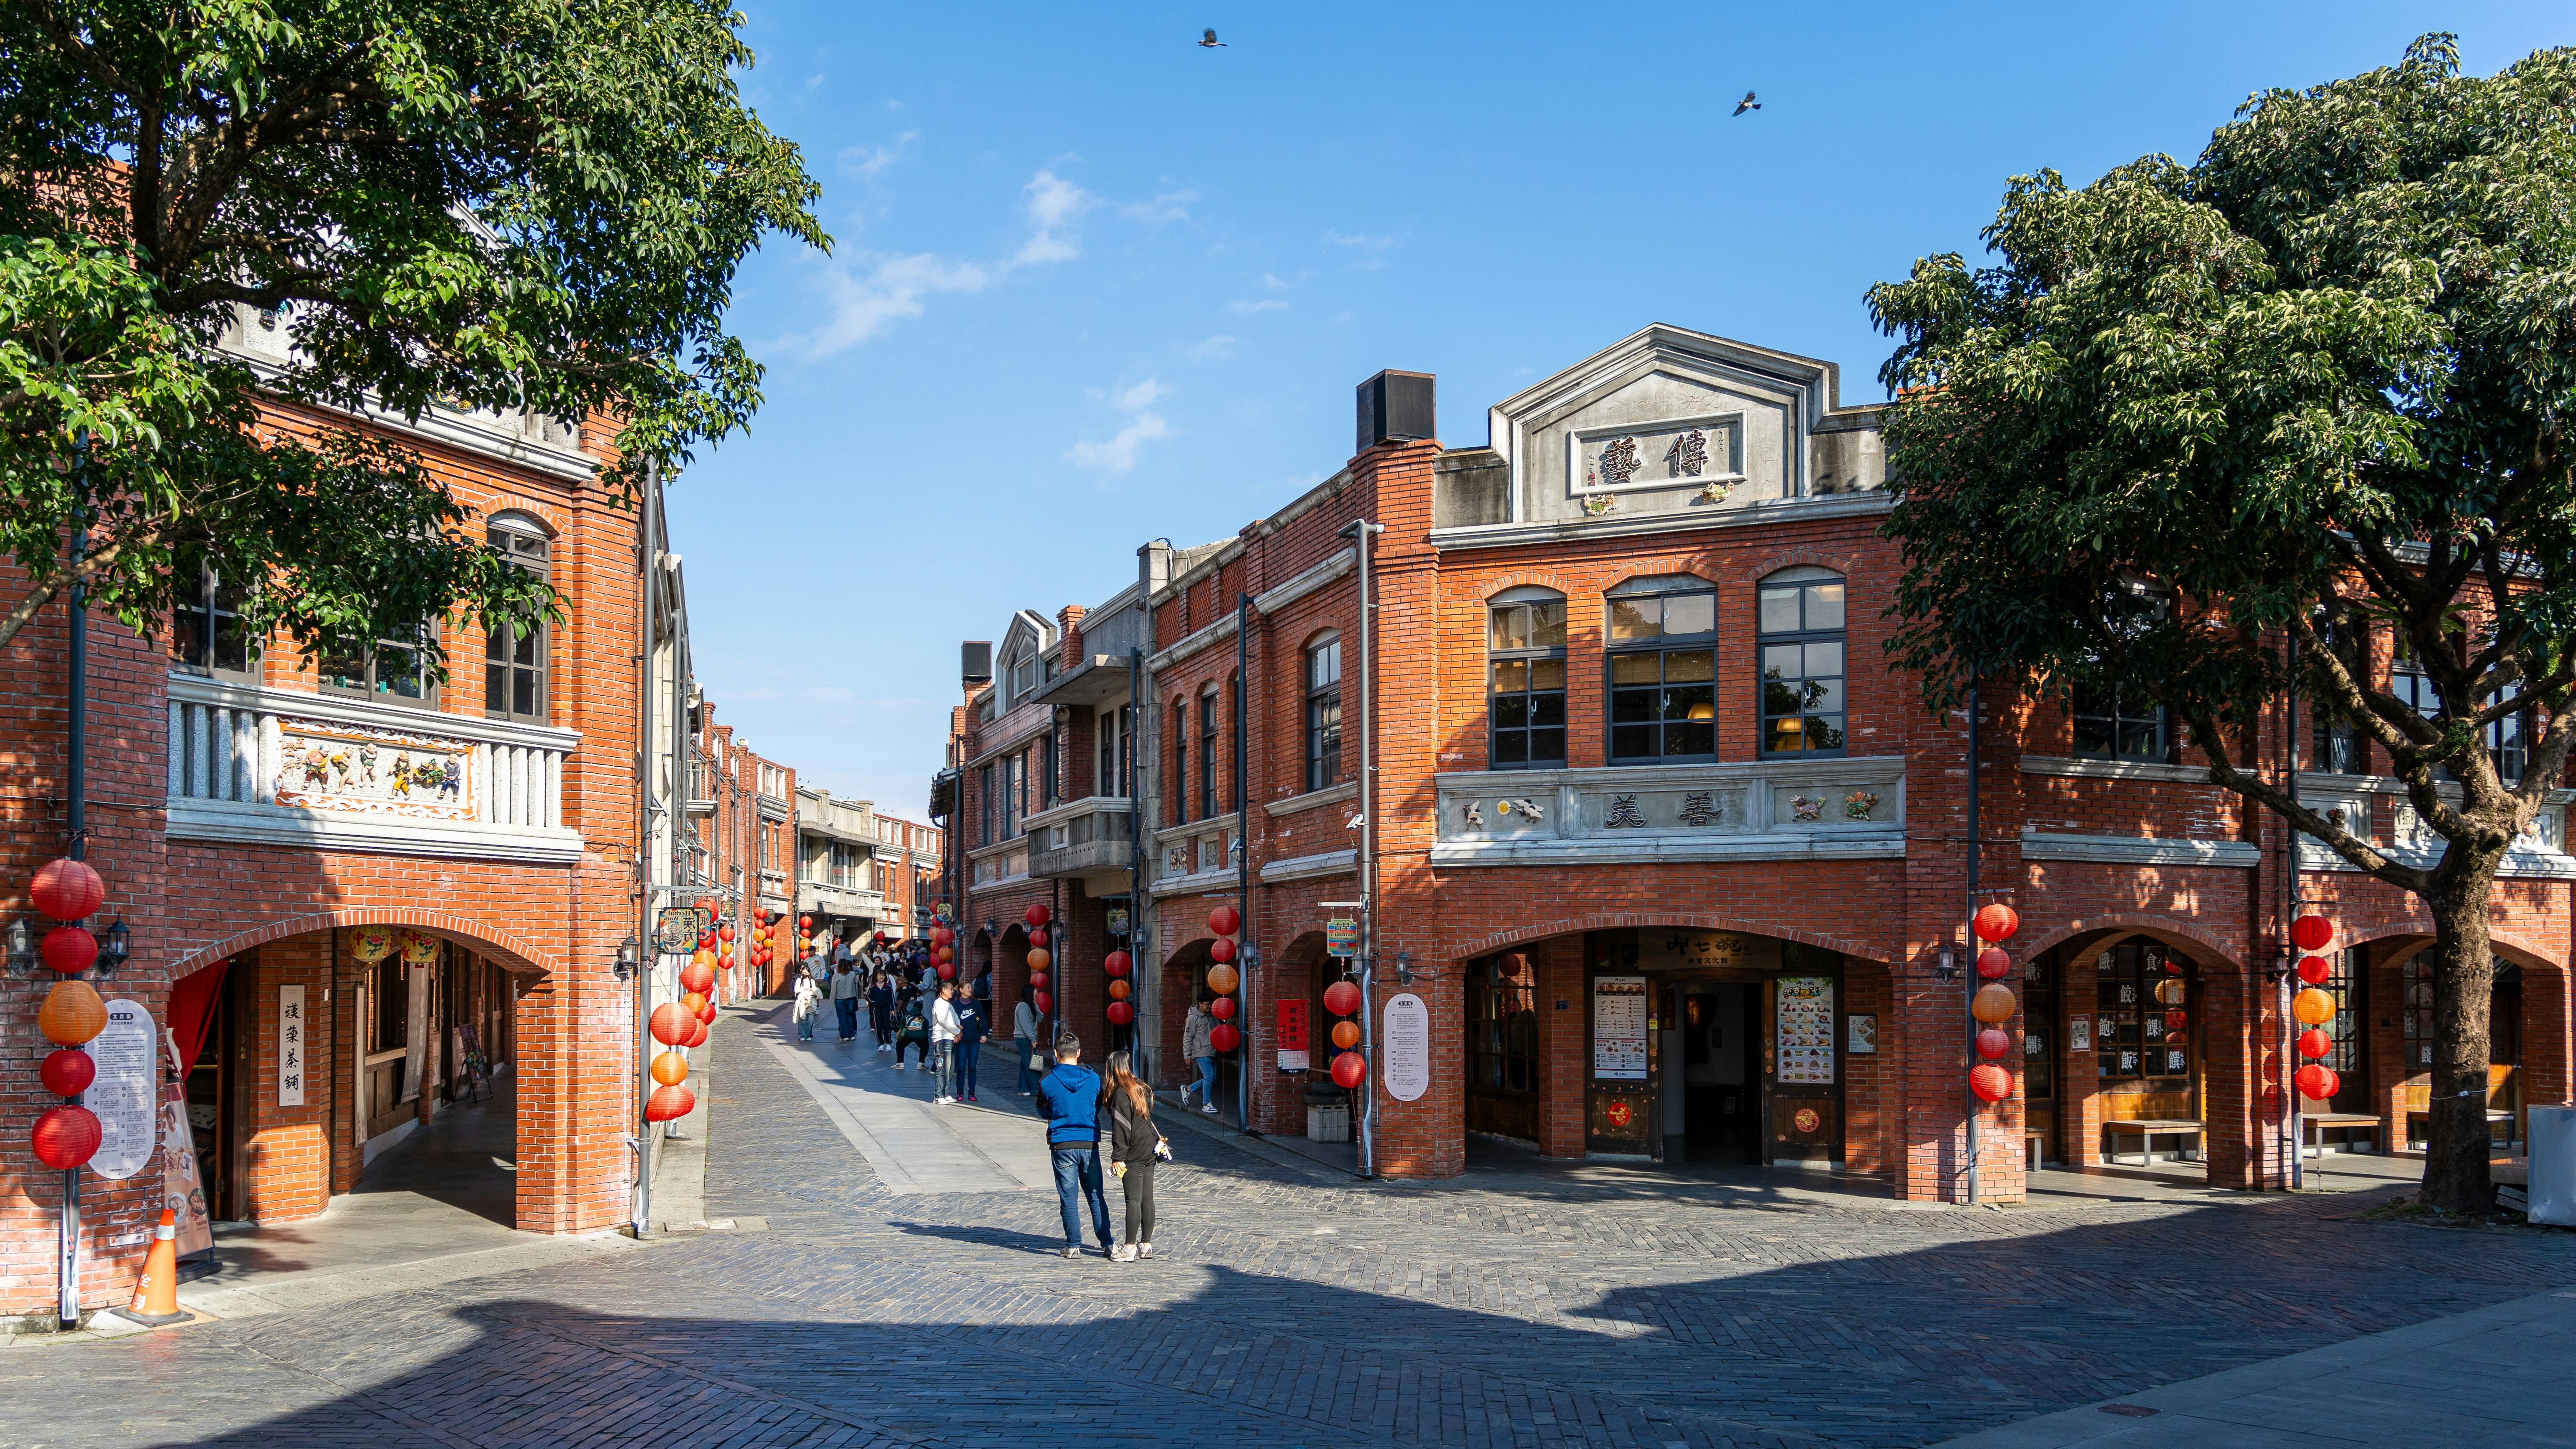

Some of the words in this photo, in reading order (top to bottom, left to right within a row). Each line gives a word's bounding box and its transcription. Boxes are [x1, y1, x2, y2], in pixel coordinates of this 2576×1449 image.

[1334, 923, 1350, 931] 古早
[353, 931, 365, 947] 中
[409, 931, 421, 947] 中
[2146, 953, 2157, 971] 食
[2121, 985, 2132, 1003] 餃
[2099, 1018, 2111, 1037] 飽
[2121, 1051, 2133, 1069] 飯
